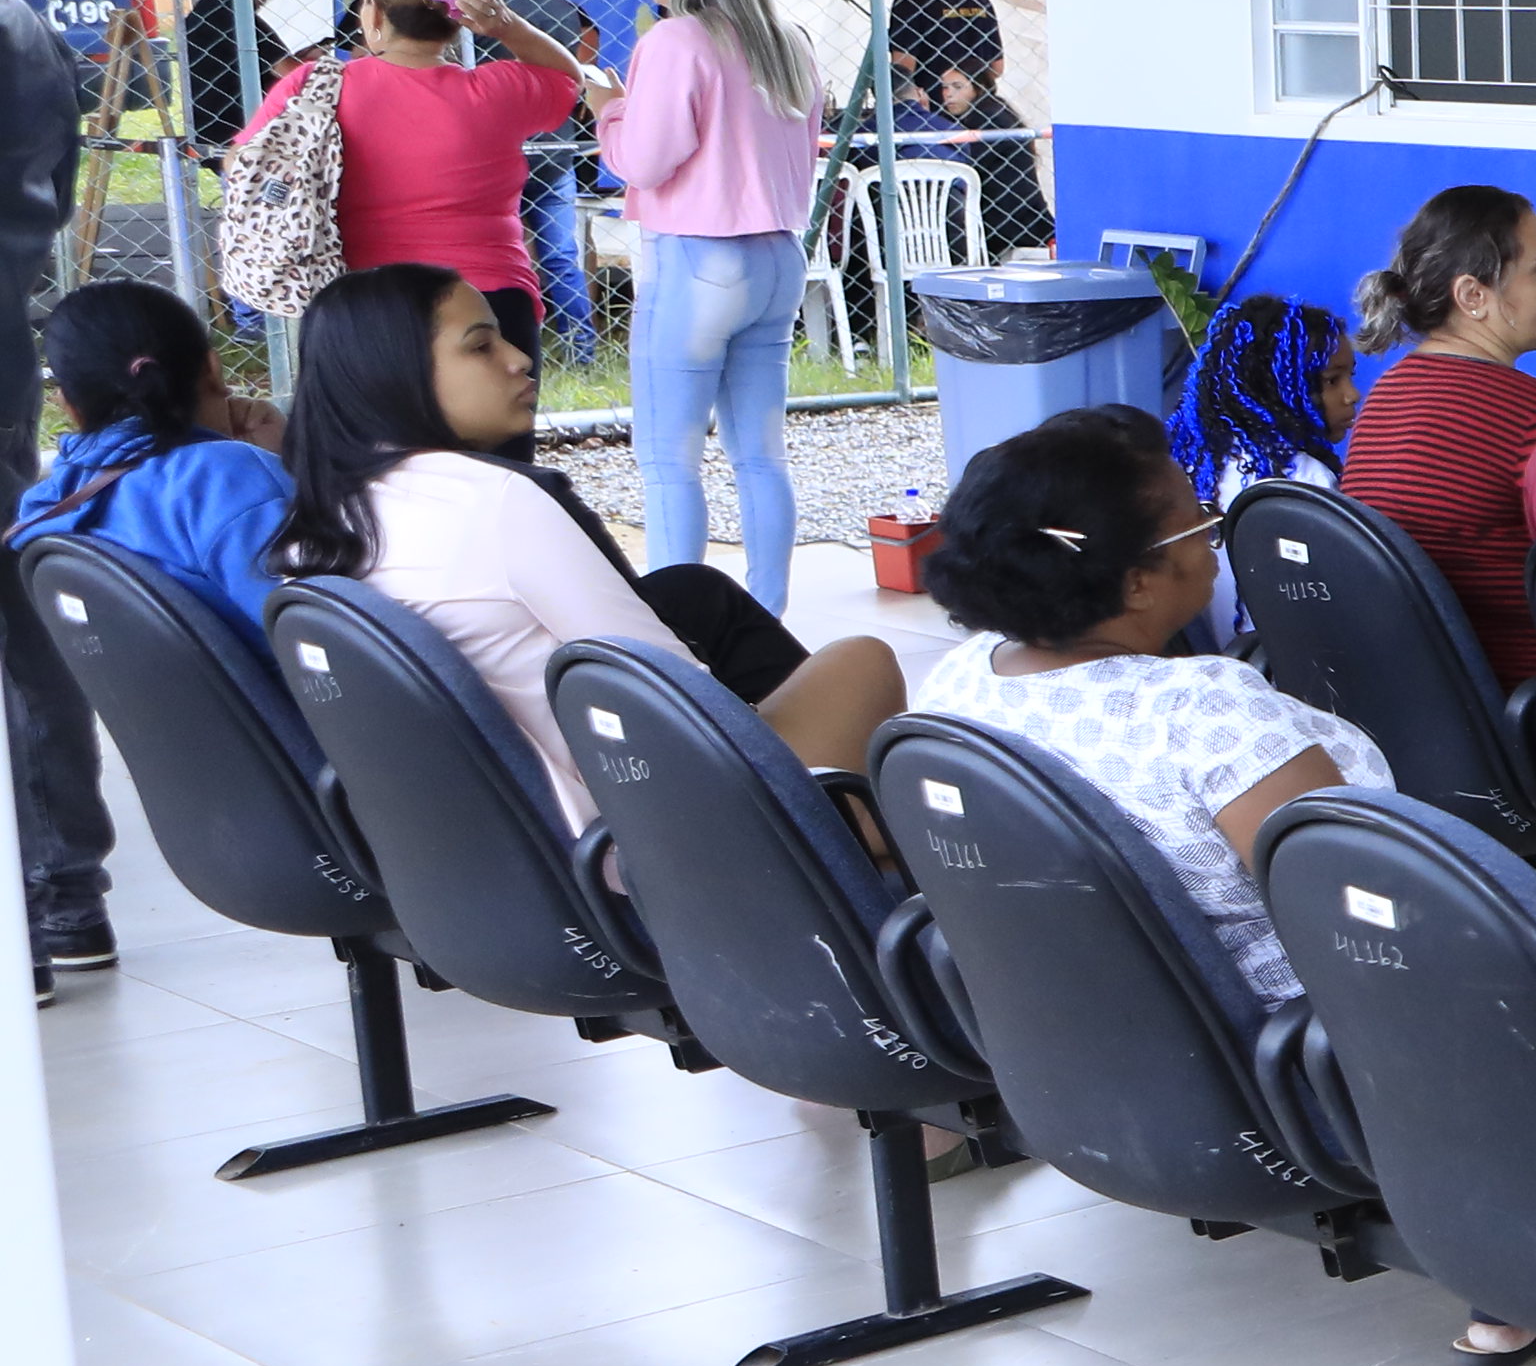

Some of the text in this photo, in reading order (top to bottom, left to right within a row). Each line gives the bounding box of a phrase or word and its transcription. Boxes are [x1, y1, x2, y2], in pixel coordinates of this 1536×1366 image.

[63, 0, 116, 24] 190
[1278, 581, 1332, 602] 41153
[926, 828, 988, 870] 41161
[563, 927, 623, 979] 41159
[1334, 930, 1411, 971] 41162
[1239, 1130, 1313, 1187] 41161
